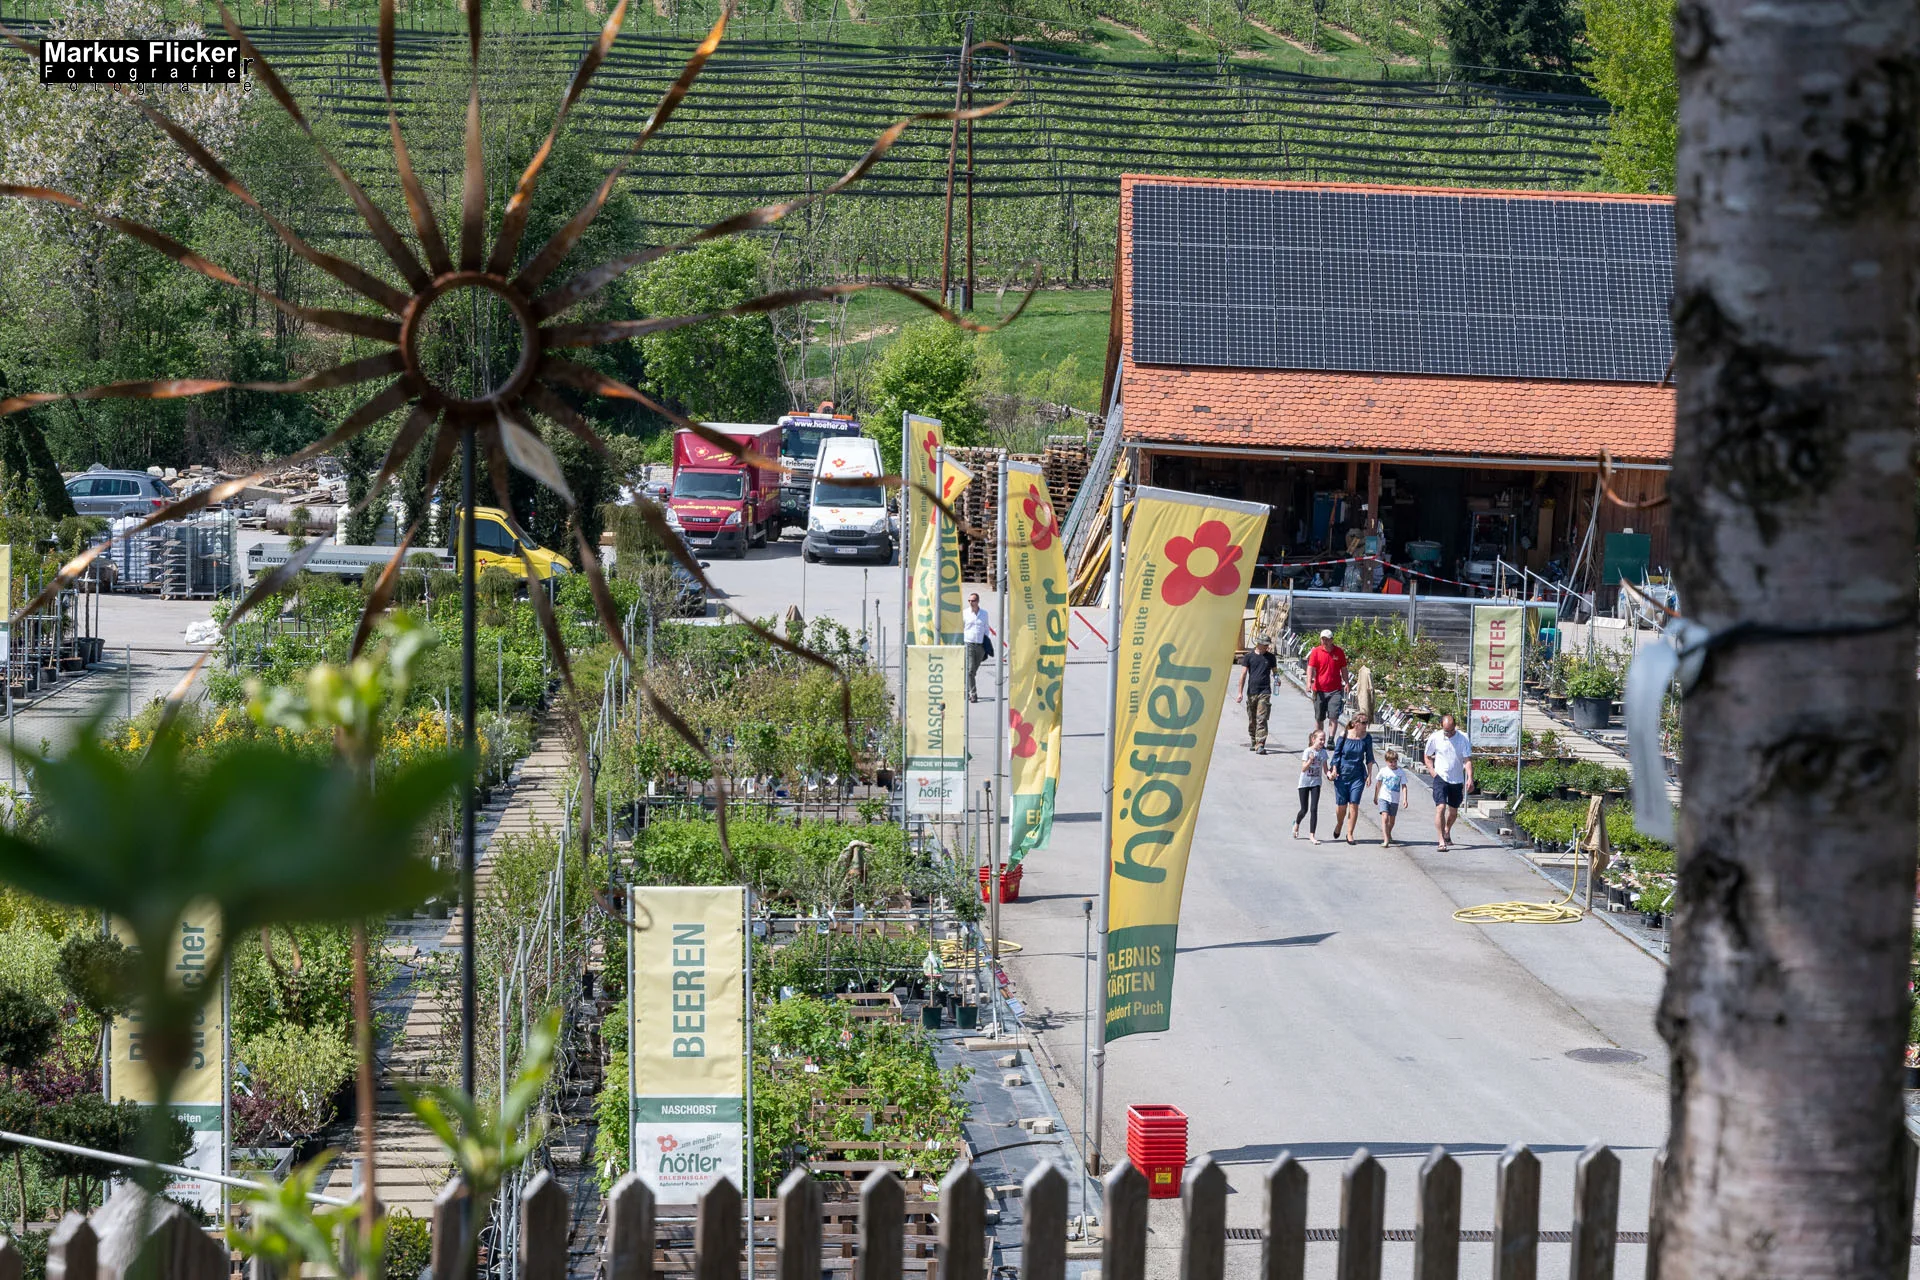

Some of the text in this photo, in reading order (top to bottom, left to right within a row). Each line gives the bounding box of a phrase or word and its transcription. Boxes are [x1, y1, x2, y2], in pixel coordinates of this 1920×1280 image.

[794, 420, 848, 430] www.hoefler.at
[1132, 606, 1149, 646] Blüte
[1129, 652, 1143, 684] eine
[1488, 619, 1506, 692] KLETTER
[928, 653, 944, 750] NASCHOBST
[1480, 700, 1511, 710] ROSEN
[1480, 724, 1509, 733] höfler
[1114, 643, 1212, 884] höfler
[919, 786, 953, 798] höfler
[1107, 945, 1162, 974] RLEBNIS
[672, 923, 705, 1058] BEEREN
[1133, 1000, 1164, 1016] Puch
[661, 1104, 718, 1115] NASCHOBST
[658, 1152, 722, 1174] höfler
